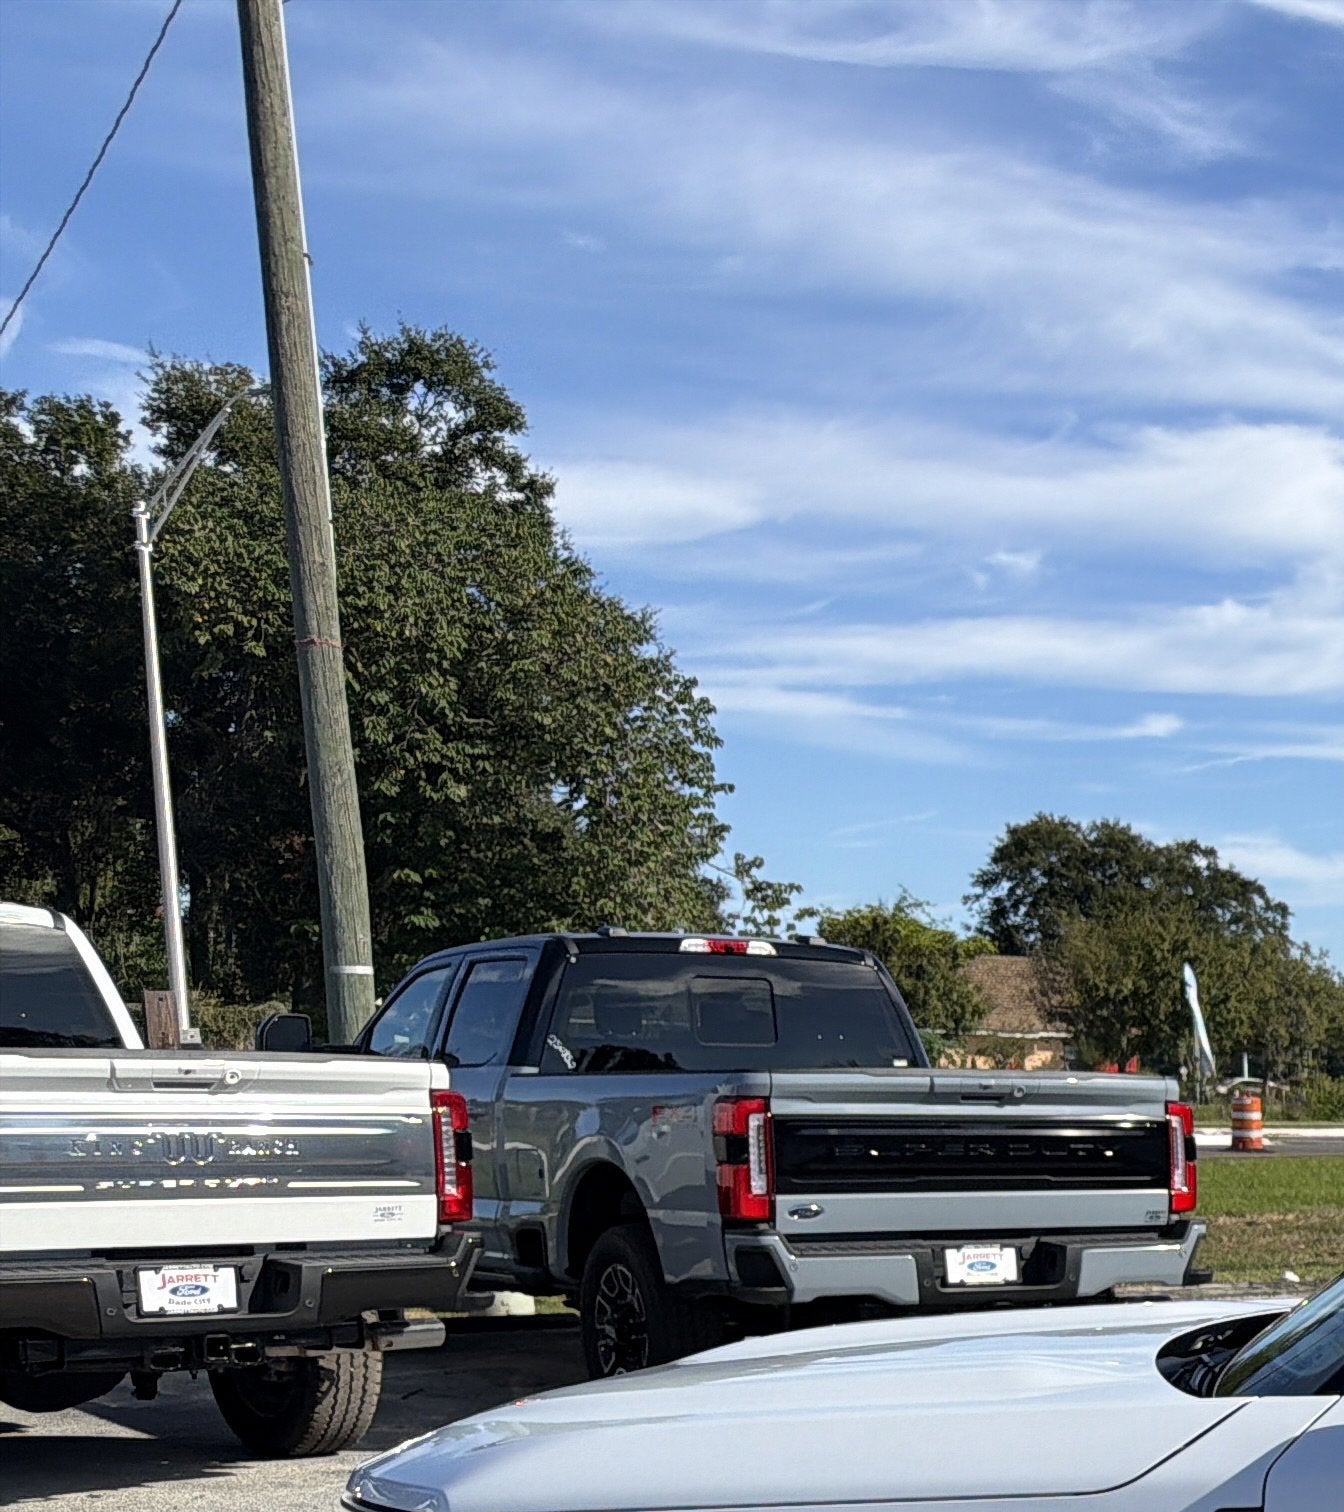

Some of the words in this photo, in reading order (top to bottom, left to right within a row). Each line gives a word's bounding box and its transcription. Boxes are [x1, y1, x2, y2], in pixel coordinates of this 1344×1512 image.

[959, 1252, 1004, 1265] JARRETT
[157, 1273, 219, 1290] JARRETT
[176, 1285, 202, 1296] Ford
